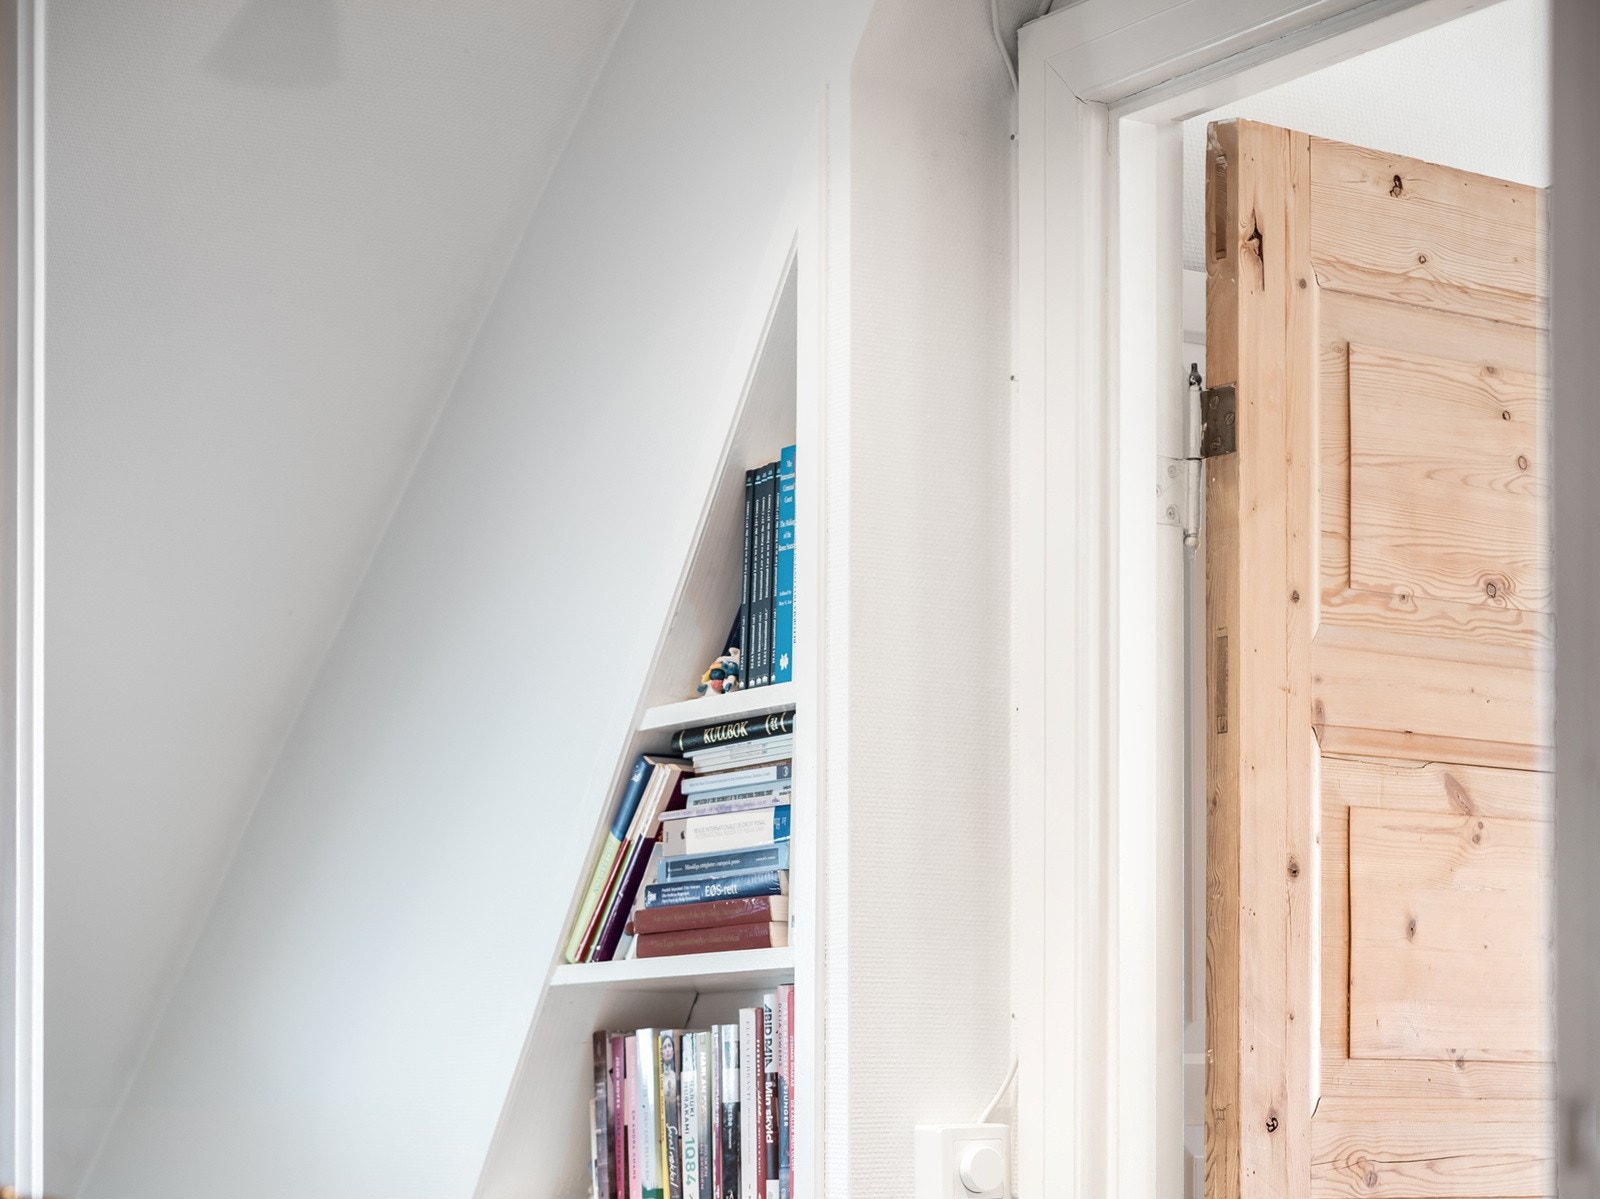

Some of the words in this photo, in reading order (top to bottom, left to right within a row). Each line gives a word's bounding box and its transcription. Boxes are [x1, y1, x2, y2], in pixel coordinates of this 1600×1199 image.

[703, 721, 748, 744] KULLBOK
[782, 767, 789, 777] 3
[704, 883, 738, 898] EØS-rett
[763, 1003, 772, 1035] ABID
[764, 1038, 773, 1068] RAJA
[764, 1080, 772, 1105] Min
[764, 1108, 773, 1143] skyld
[683, 1136, 696, 1185] 1Q84
